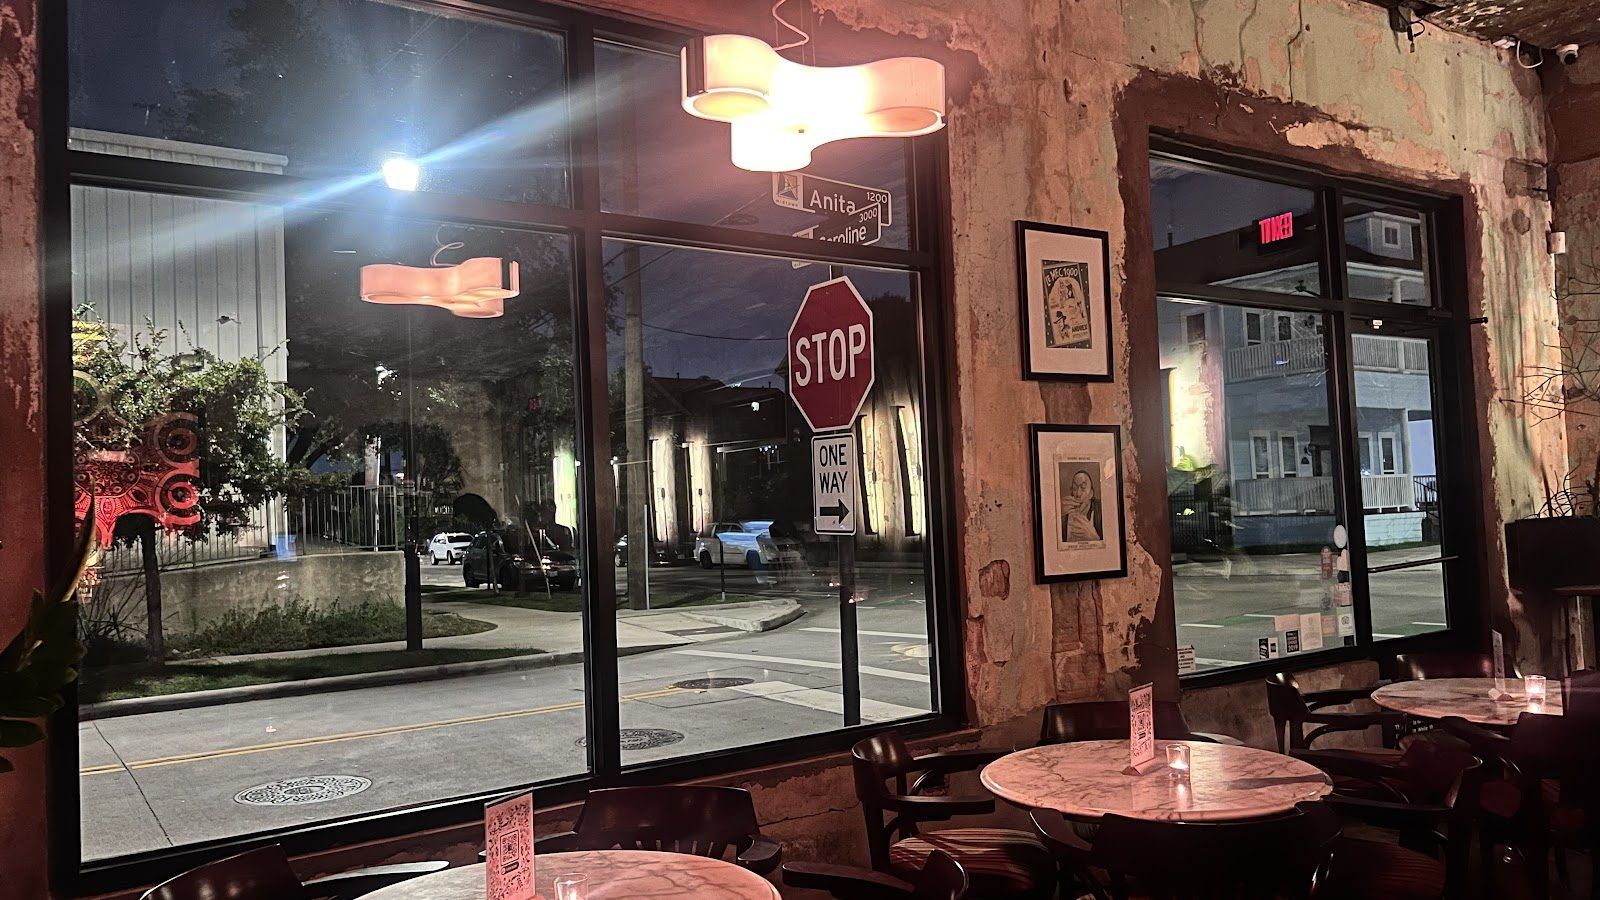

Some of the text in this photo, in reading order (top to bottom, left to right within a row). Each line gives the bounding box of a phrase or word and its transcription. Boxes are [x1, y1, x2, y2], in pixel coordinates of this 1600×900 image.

[809, 190, 856, 213] Anita
[866, 191, 887, 204] 1200
[858, 207, 878, 223] 3000
[819, 226, 867, 244] roline
[795, 323, 866, 387] STOP
[819, 444, 847, 468] ONE
[819, 470, 848, 494] WAY
